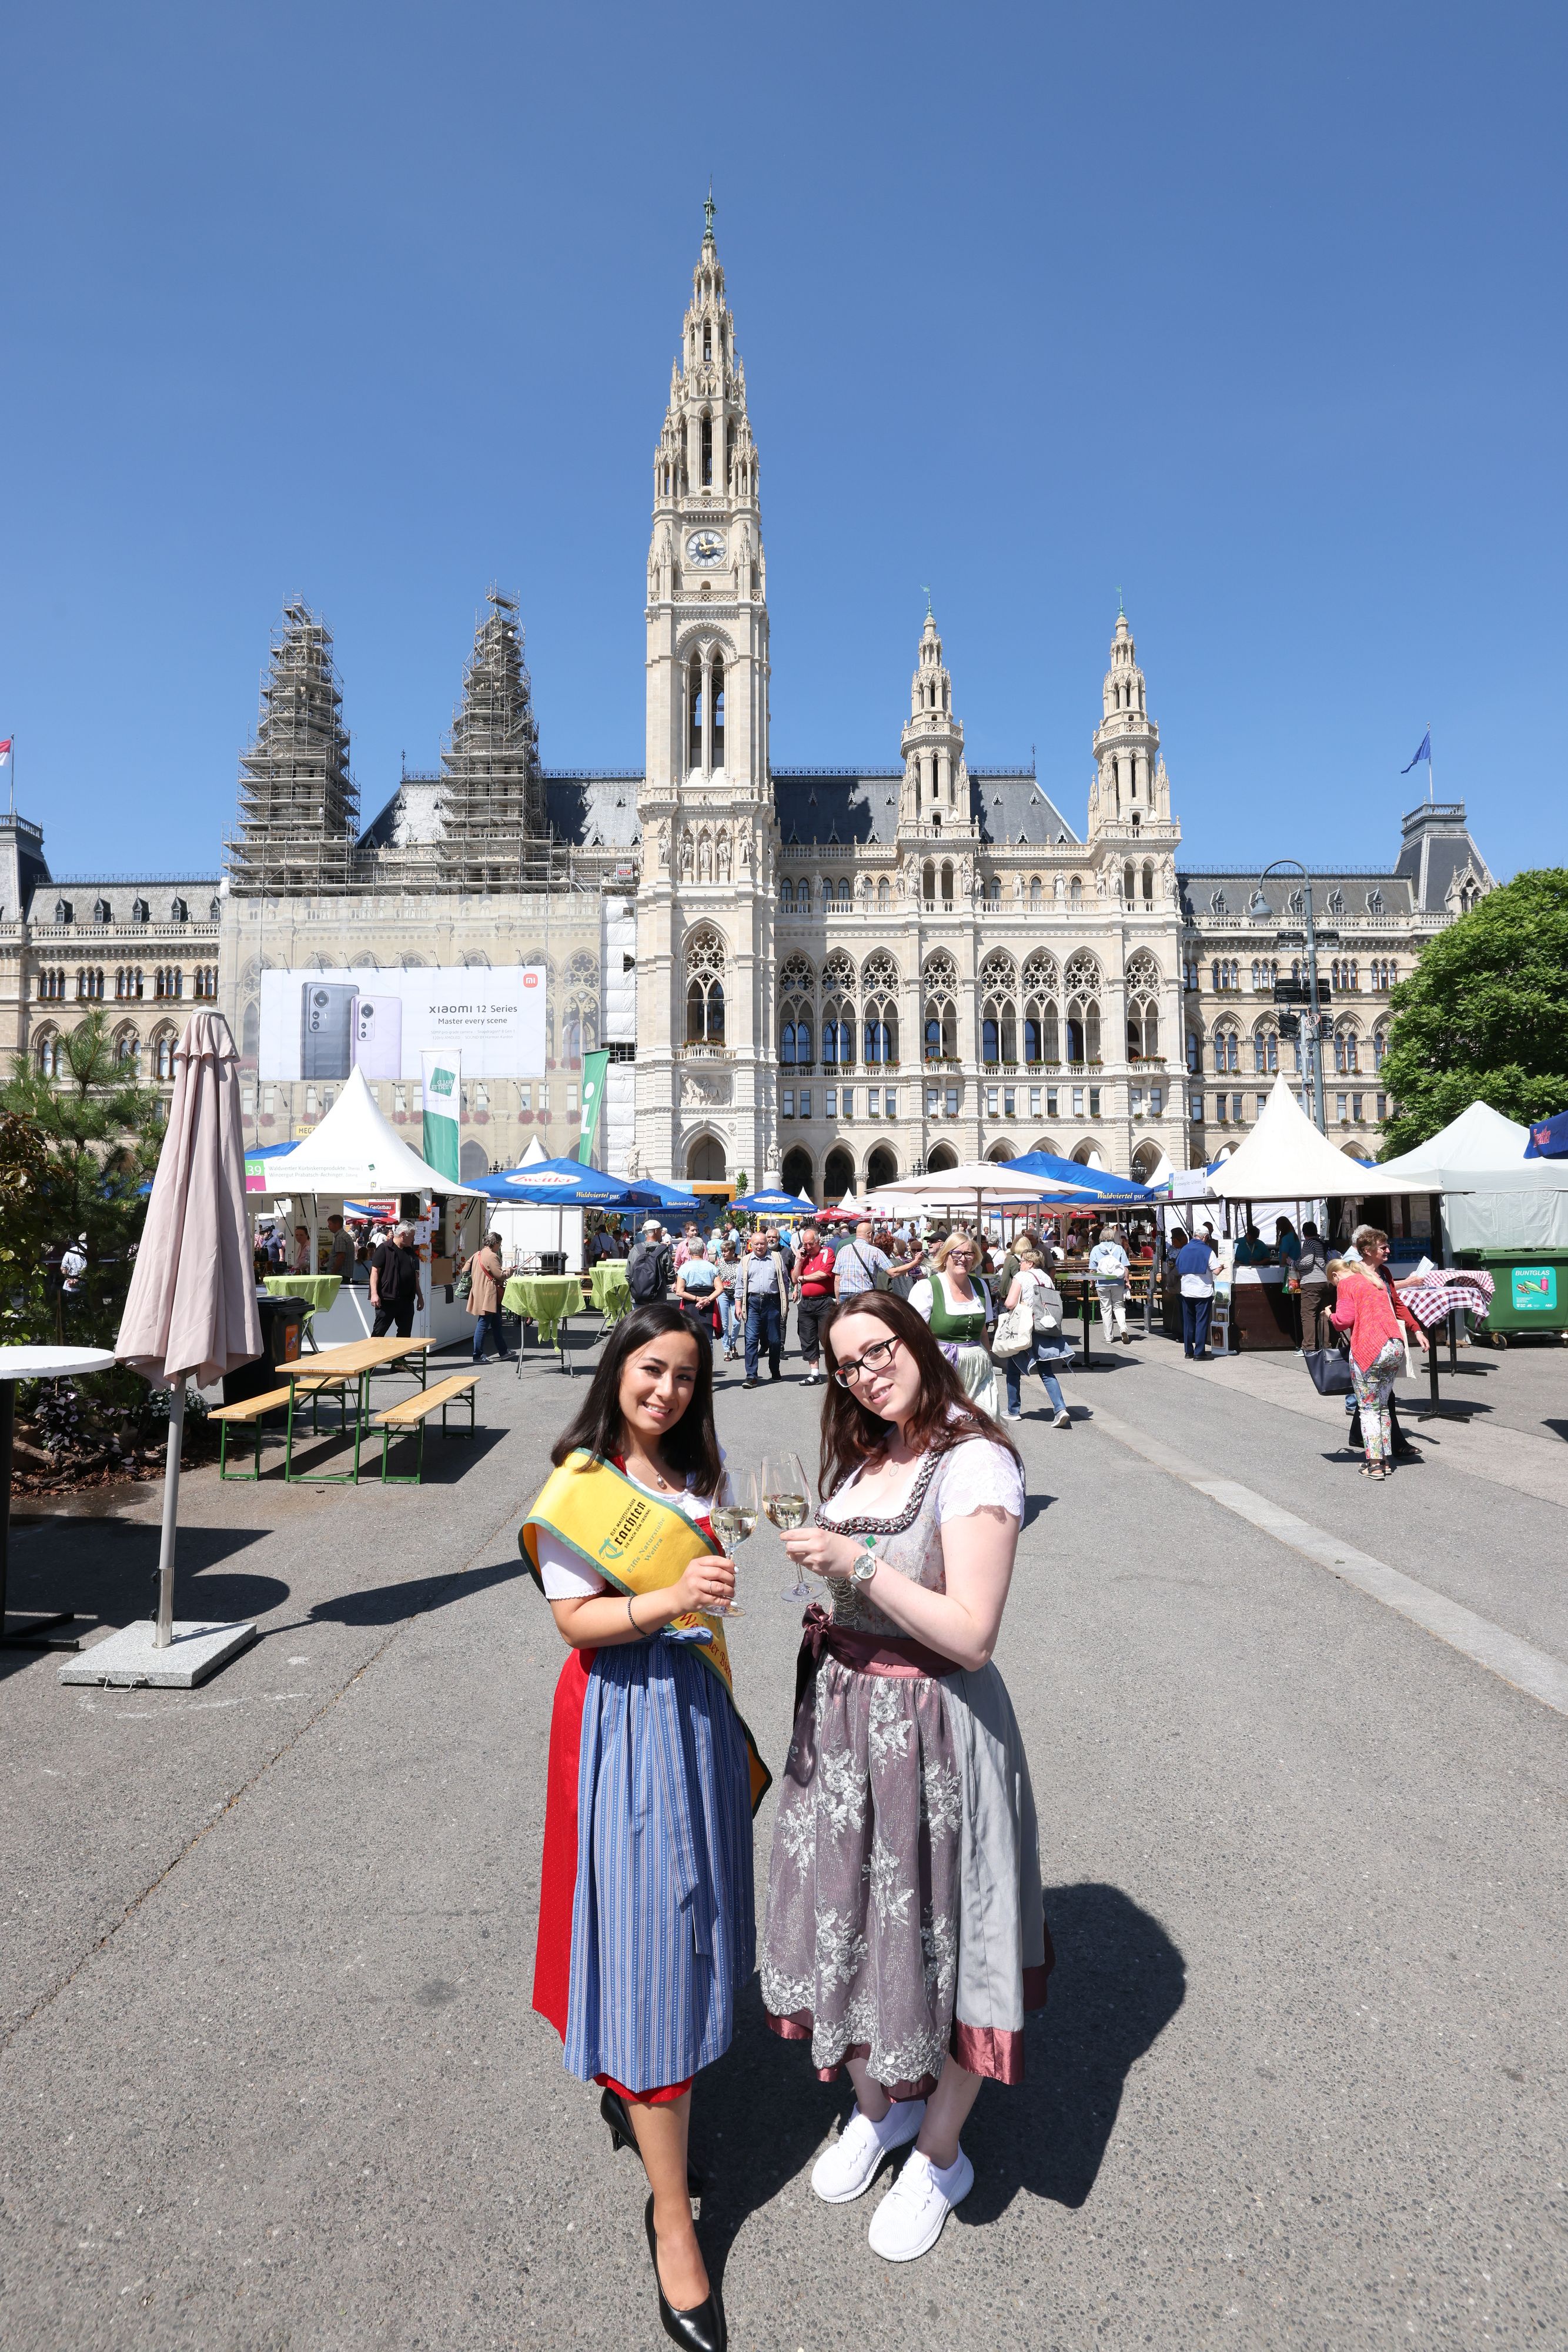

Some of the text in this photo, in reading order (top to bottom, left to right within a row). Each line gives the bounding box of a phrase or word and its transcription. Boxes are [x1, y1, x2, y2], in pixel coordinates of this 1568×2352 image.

[247, 1165, 262, 1175] 39
[599, 1501, 646, 1560] Trachten
[610, 1528, 618, 1536] ELFI
[628, 1532, 637, 1542] NACH
[640, 1509, 651, 1524] ORIGINAL
[638, 1517, 666, 1555] Naturstube
[644, 1538, 663, 1561] Weitra
